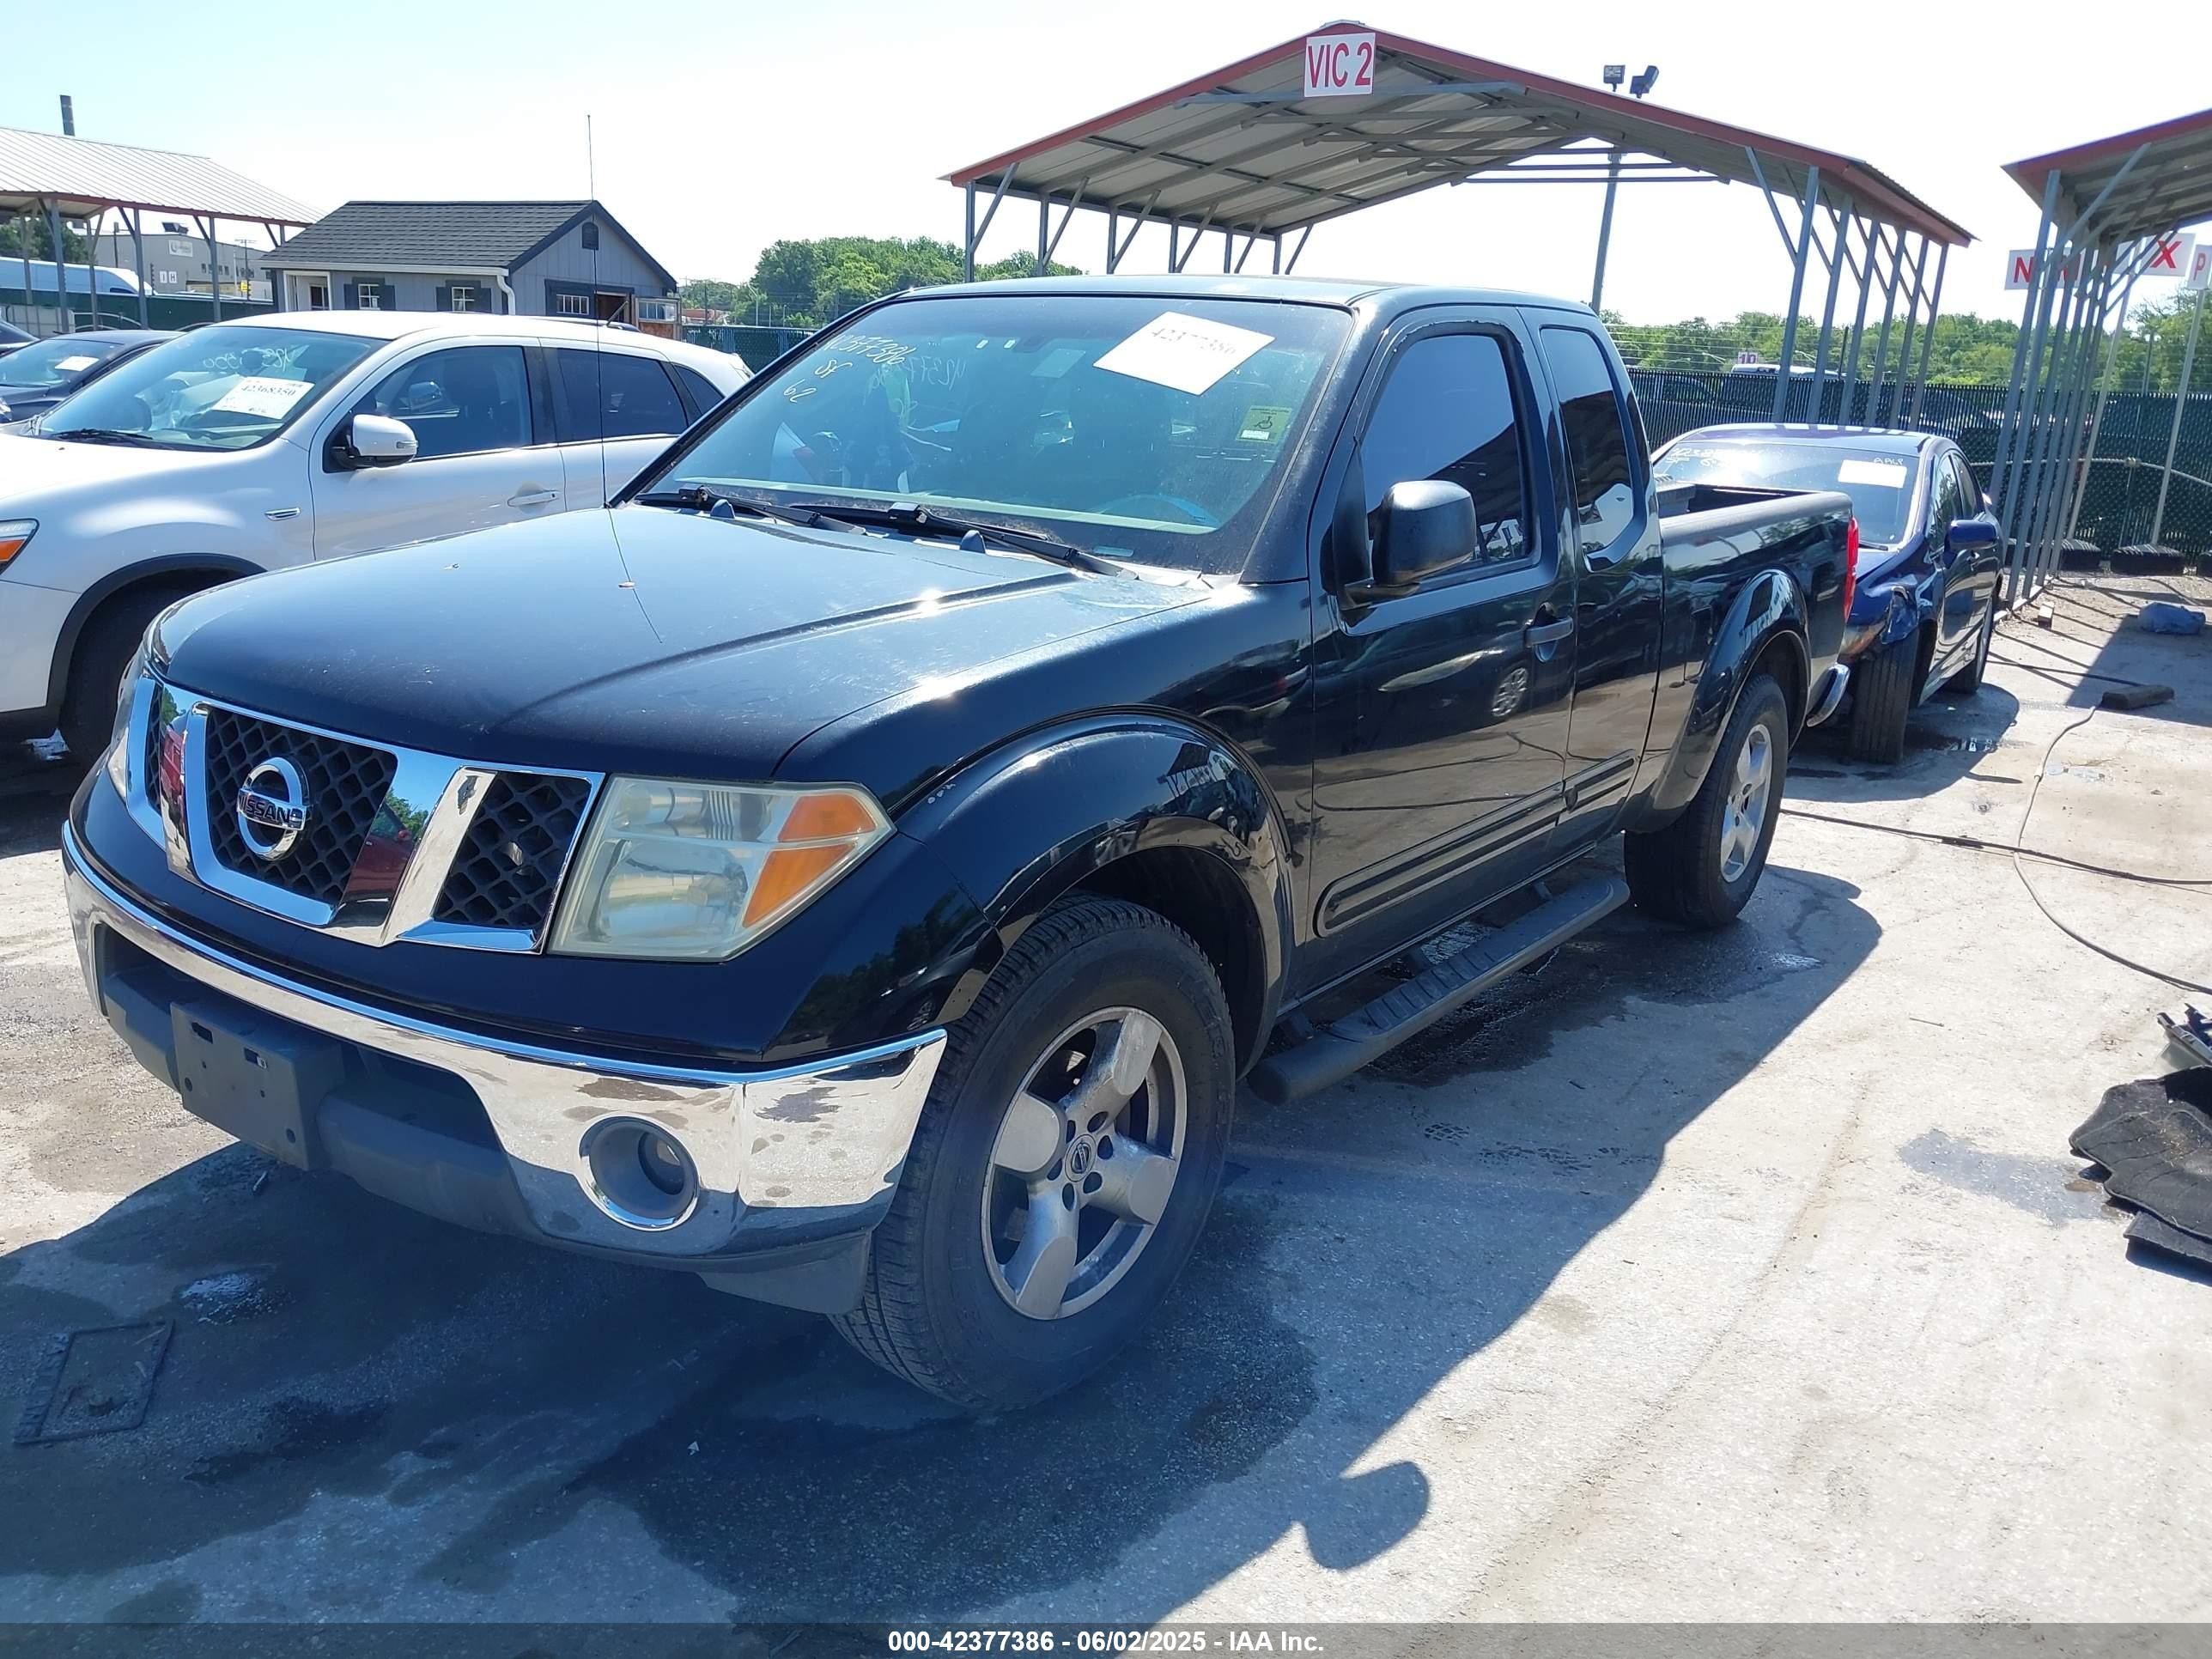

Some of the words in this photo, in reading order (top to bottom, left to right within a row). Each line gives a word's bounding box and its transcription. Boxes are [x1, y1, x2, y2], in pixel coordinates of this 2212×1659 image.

[1308, 42, 1350, 88] VIC
[1355, 41, 1372, 86] 2
[2150, 240, 2182, 269] X
